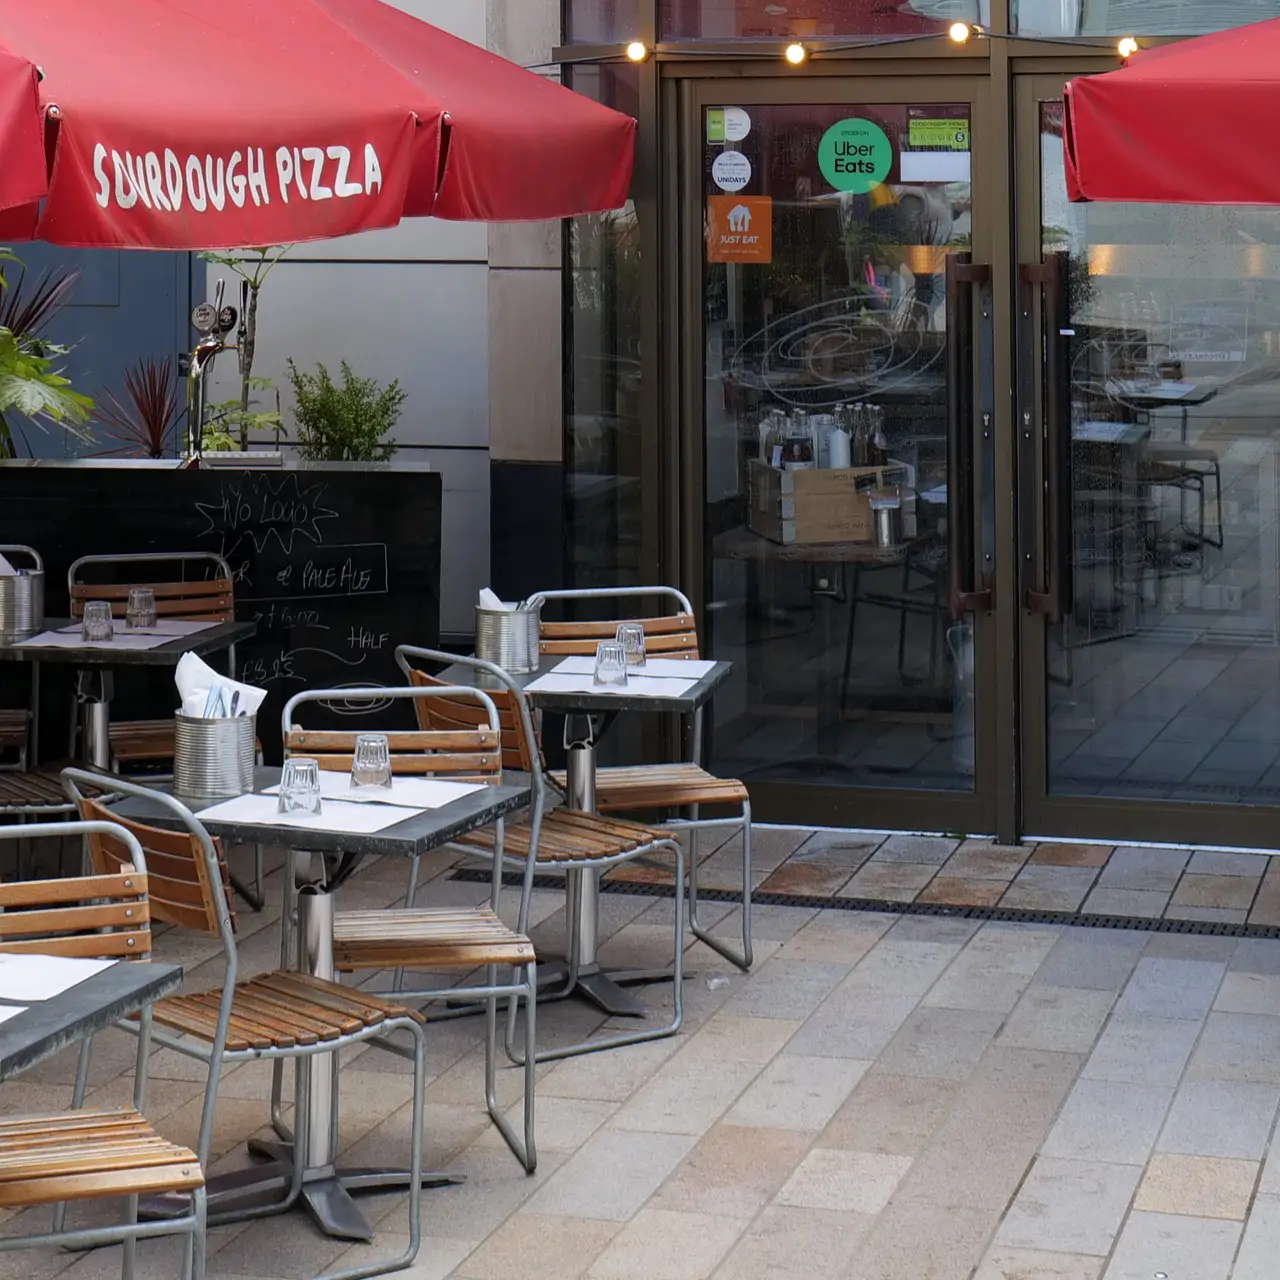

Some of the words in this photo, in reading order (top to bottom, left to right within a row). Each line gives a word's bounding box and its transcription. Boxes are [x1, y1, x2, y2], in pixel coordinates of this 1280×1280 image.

[834, 141, 875, 156] Uber
[834, 158, 875, 174] Eats
[93, 143, 270, 212] SOURDOUGH
[275, 143, 382, 204] PIZZA
[719, 234, 741, 244] JUST
[742, 234, 759, 244] EAT
[302, 558, 337, 590] PALE
[339, 557, 372, 591] ALE
[346, 625, 390, 649] HALF
